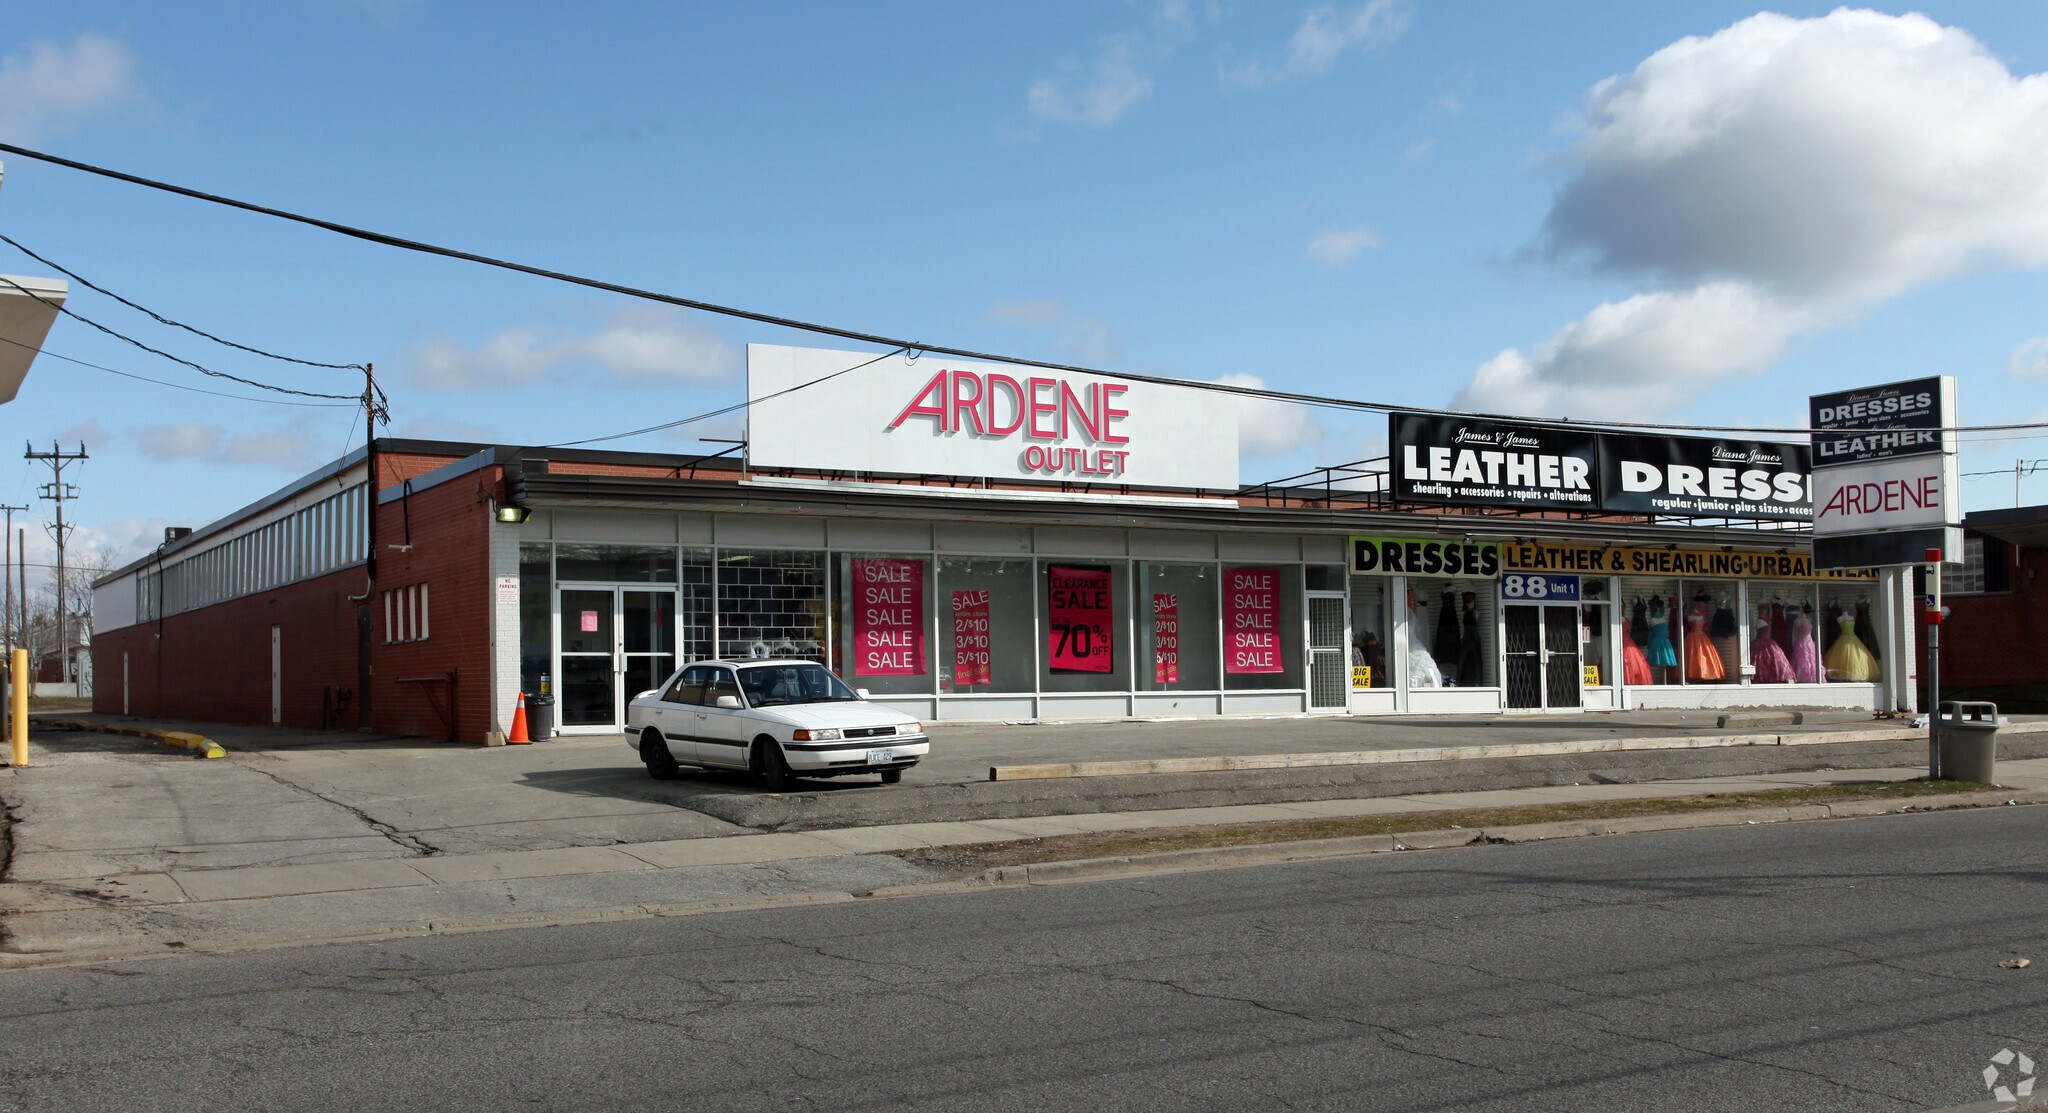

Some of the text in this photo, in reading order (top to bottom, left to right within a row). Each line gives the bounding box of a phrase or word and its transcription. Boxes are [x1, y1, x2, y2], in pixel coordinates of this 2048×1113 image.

[889, 368, 1130, 444] ARDENE
[1819, 392, 1932, 423] DRESSES
[1845, 419, 1859, 427] junior
[1900, 409, 1930, 418] accessories
[1455, 426, 1540, 448] James & James
[1820, 431, 1935, 457] LEATHER
[1025, 445, 1129, 474] OUTLET
[1711, 445, 1782, 464] Diana James
[1404, 445, 1591, 490] LEATHER
[1412, 482, 1592, 502] shearling accessories repairs alterations
[1818, 475, 1939, 518] ARDENE
[1652, 497, 1813, 516] regular junior plus sizes acces
[1354, 540, 1498, 576] DRESSES
[1507, 546, 1604, 571] LEATHER
[1611, 550, 1626, 571] &
[1632, 551, 1746, 575] SHEARLING
[865, 566, 911, 583] SALE
[1234, 575, 1271, 590] SALE
[1052, 577, 1107, 590] CLEARANCE
[1504, 575, 1574, 598] 88 Unit 1
[866, 588, 912, 604] SALE
[952, 590, 990, 611] SALE
[1053, 591, 1108, 609] SALE
[1153, 594, 1177, 613] SALE
[1234, 594, 1272, 609] SALE
[866, 609, 912, 626] SALE
[955, 618, 988, 632] 2/$10
[1235, 613, 1272, 629] SALE
[867, 630, 913, 647] SALE
[956, 635, 988, 648] 3/$10
[1235, 633, 1273, 648] SALE
[957, 652, 989, 665] 5/$10
[1092, 646, 1109, 657] OFF
[1236, 652, 1274, 667] SALE
[868, 652, 914, 669] SALE
[974, 665, 989, 675] sale
[1353, 668, 1367, 676] BIG
[1584, 667, 1595, 675] BIG
[1352, 678, 1369, 686] SALE
[1584, 676, 1598, 684] SALE
